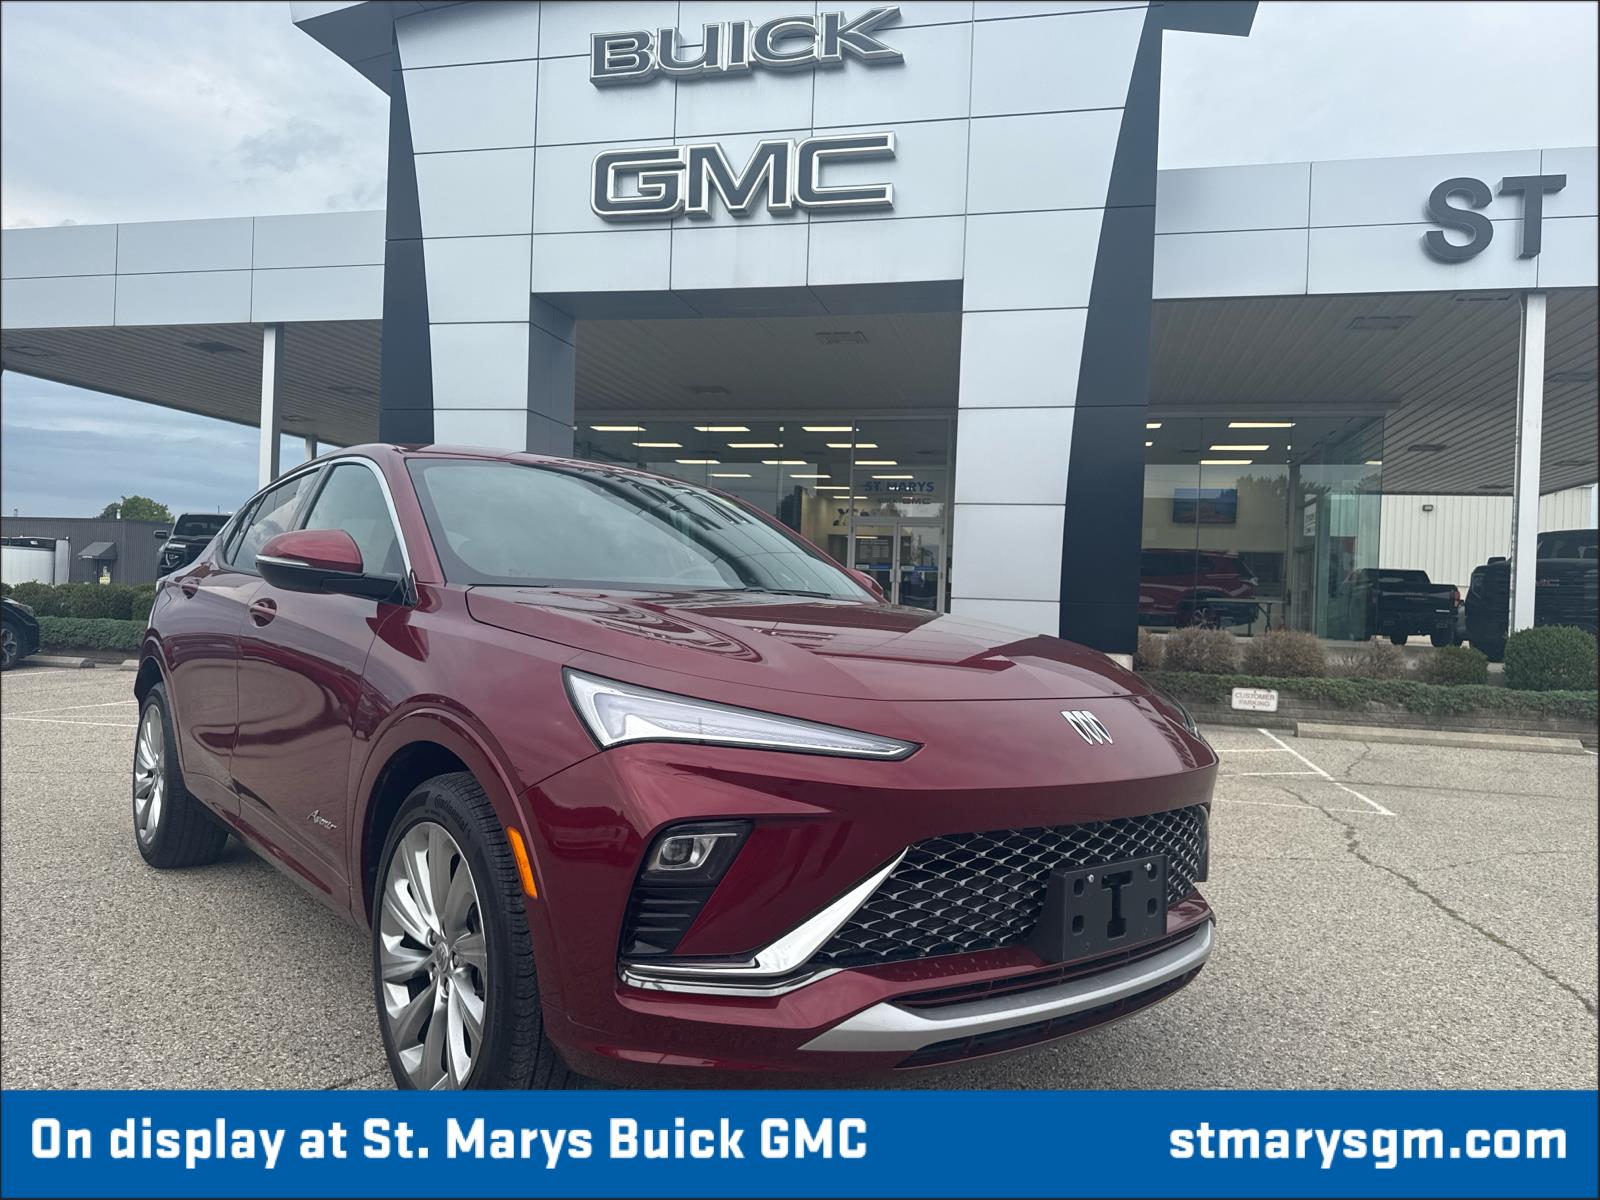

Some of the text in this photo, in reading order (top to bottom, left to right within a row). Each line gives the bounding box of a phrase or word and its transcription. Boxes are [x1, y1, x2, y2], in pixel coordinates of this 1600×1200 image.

[590, 6, 904, 87] BUICK
[590, 131, 896, 220] GMC
[1422, 174, 1567, 264] ST
[887, 481, 935, 492] MARYS
[1234, 692, 1275, 701] CUSTOMER
[1238, 699, 1271, 707] PARKING
